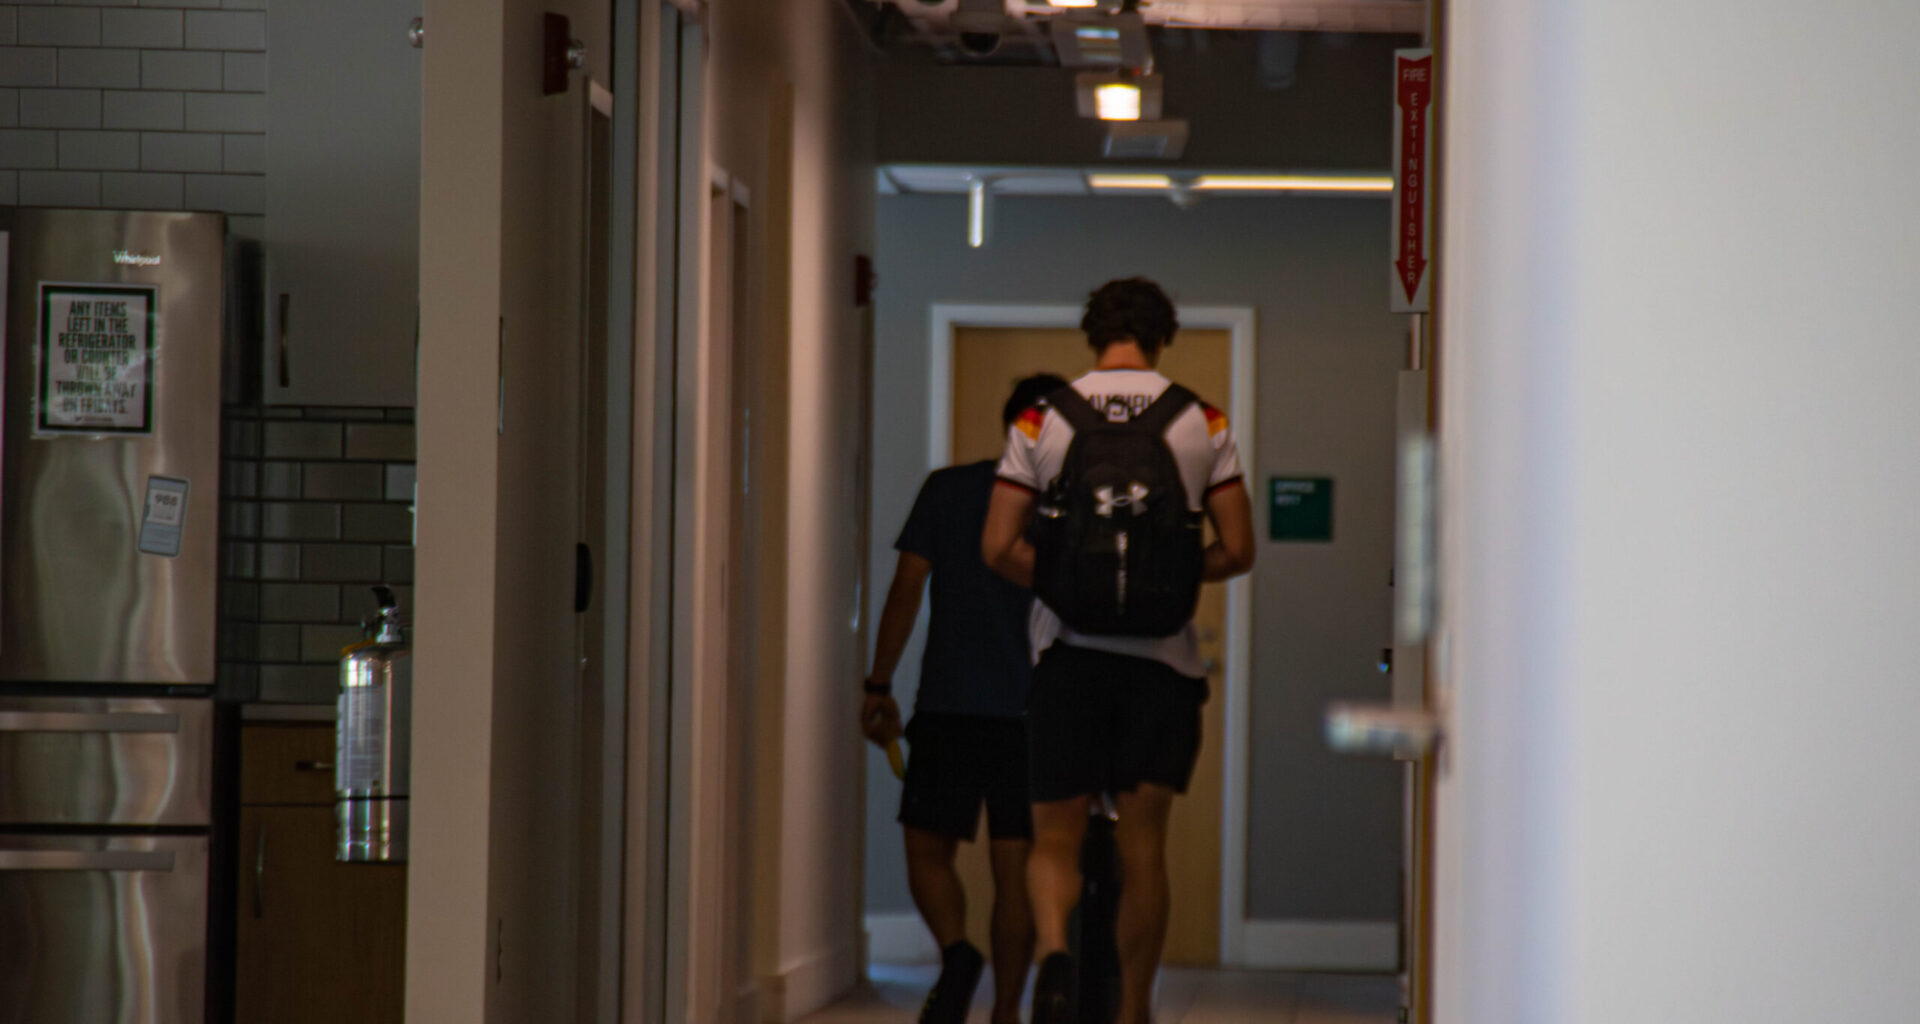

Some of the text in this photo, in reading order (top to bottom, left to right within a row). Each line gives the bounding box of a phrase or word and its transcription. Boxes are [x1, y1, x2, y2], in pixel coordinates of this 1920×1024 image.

[1402, 68, 1428, 82] FIRE
[1407, 92, 1419, 284] EXTINGUISHER
[112, 250, 161, 266] Whirlpool
[70, 301, 127, 317] ANY ITEMS
[67, 316, 129, 333] LEFT IN THE
[58, 332, 136, 349] REFRIGERATOR
[64, 349, 79, 364] OR
